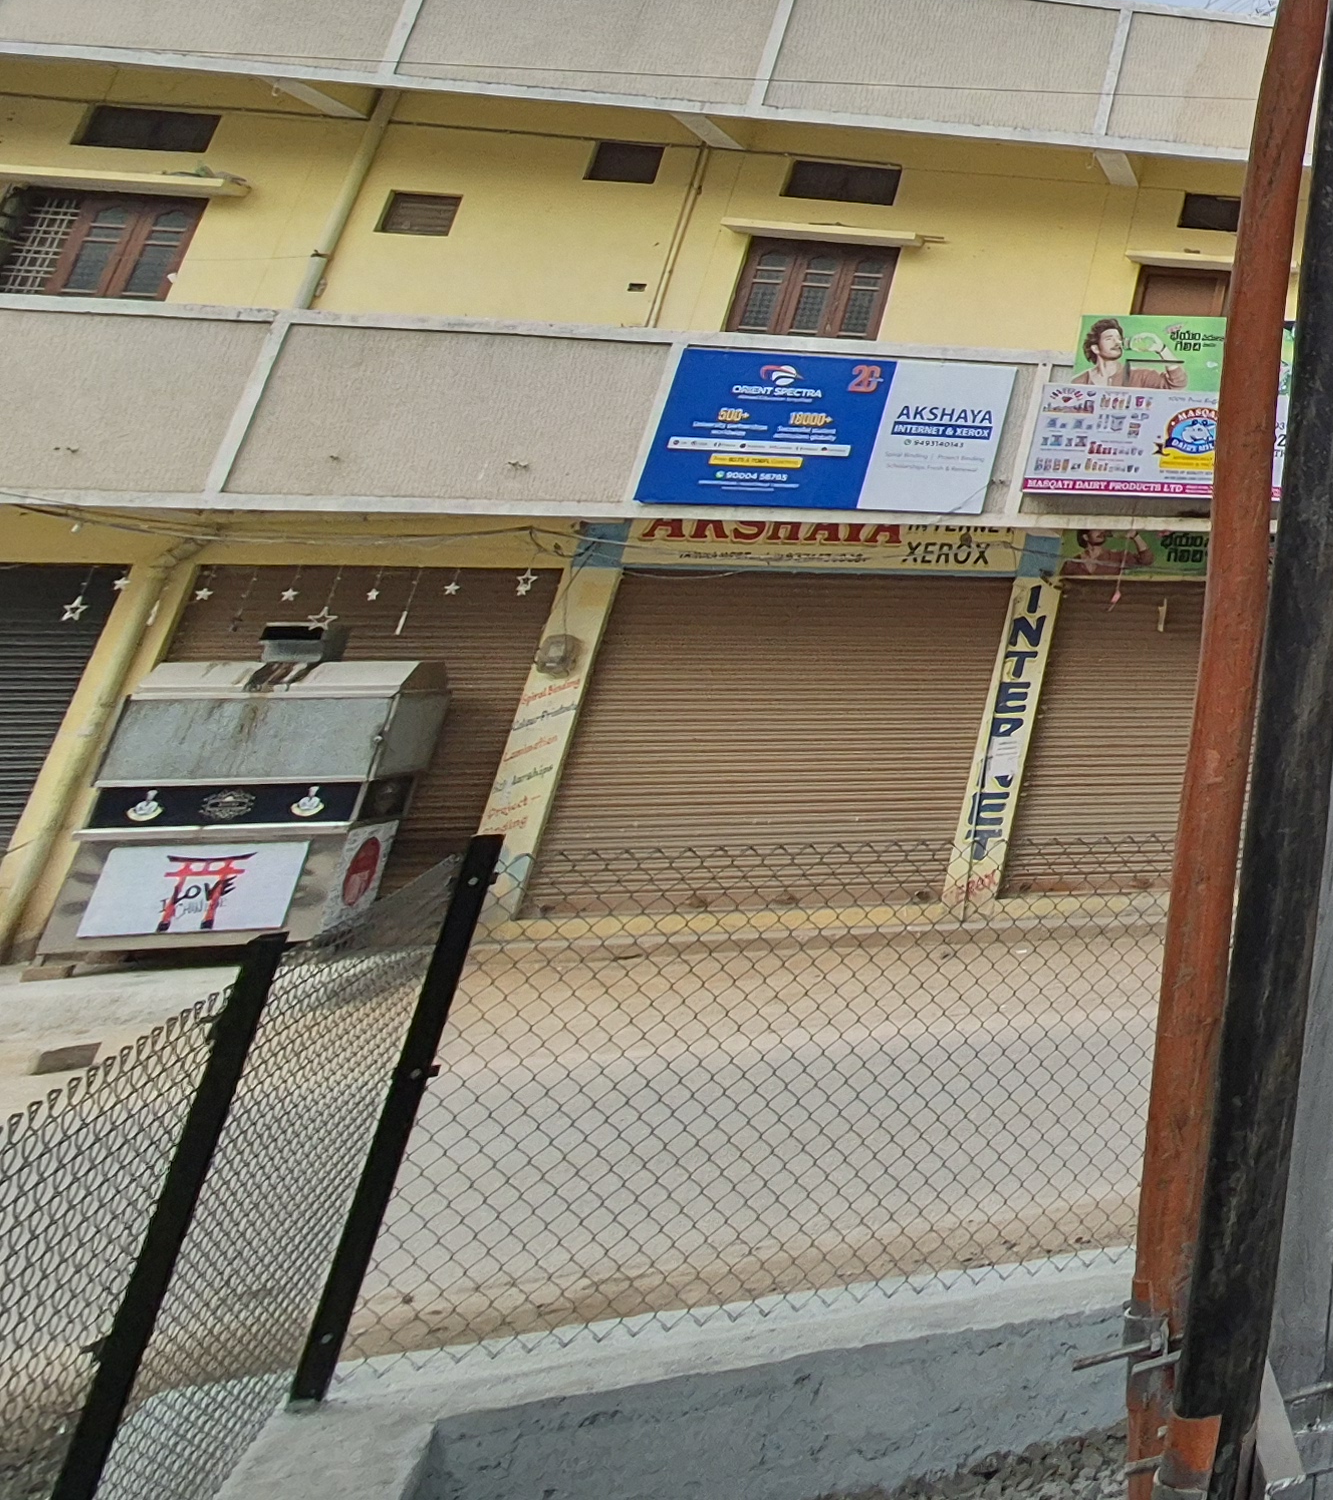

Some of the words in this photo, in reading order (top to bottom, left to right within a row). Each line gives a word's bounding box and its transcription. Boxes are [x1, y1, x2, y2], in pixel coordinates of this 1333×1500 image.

[732, 384, 773, 396] ORIENT
[774, 386, 822, 398] SPECTRA
[717, 407, 750, 422] 500+
[897, 405, 993, 424] AKSHAYA
[894, 424, 944, 435] INTERNET
[945, 427, 954, 435] &
[955, 427, 989, 437] XEROX
[1027, 478, 1074, 489] MASQATI
[1075, 480, 1107, 490] DAIRY
[1109, 481, 1161, 492] PRODUCTS
[1163, 482, 1183, 493] LTD
[901, 541, 990, 565] XEROX
